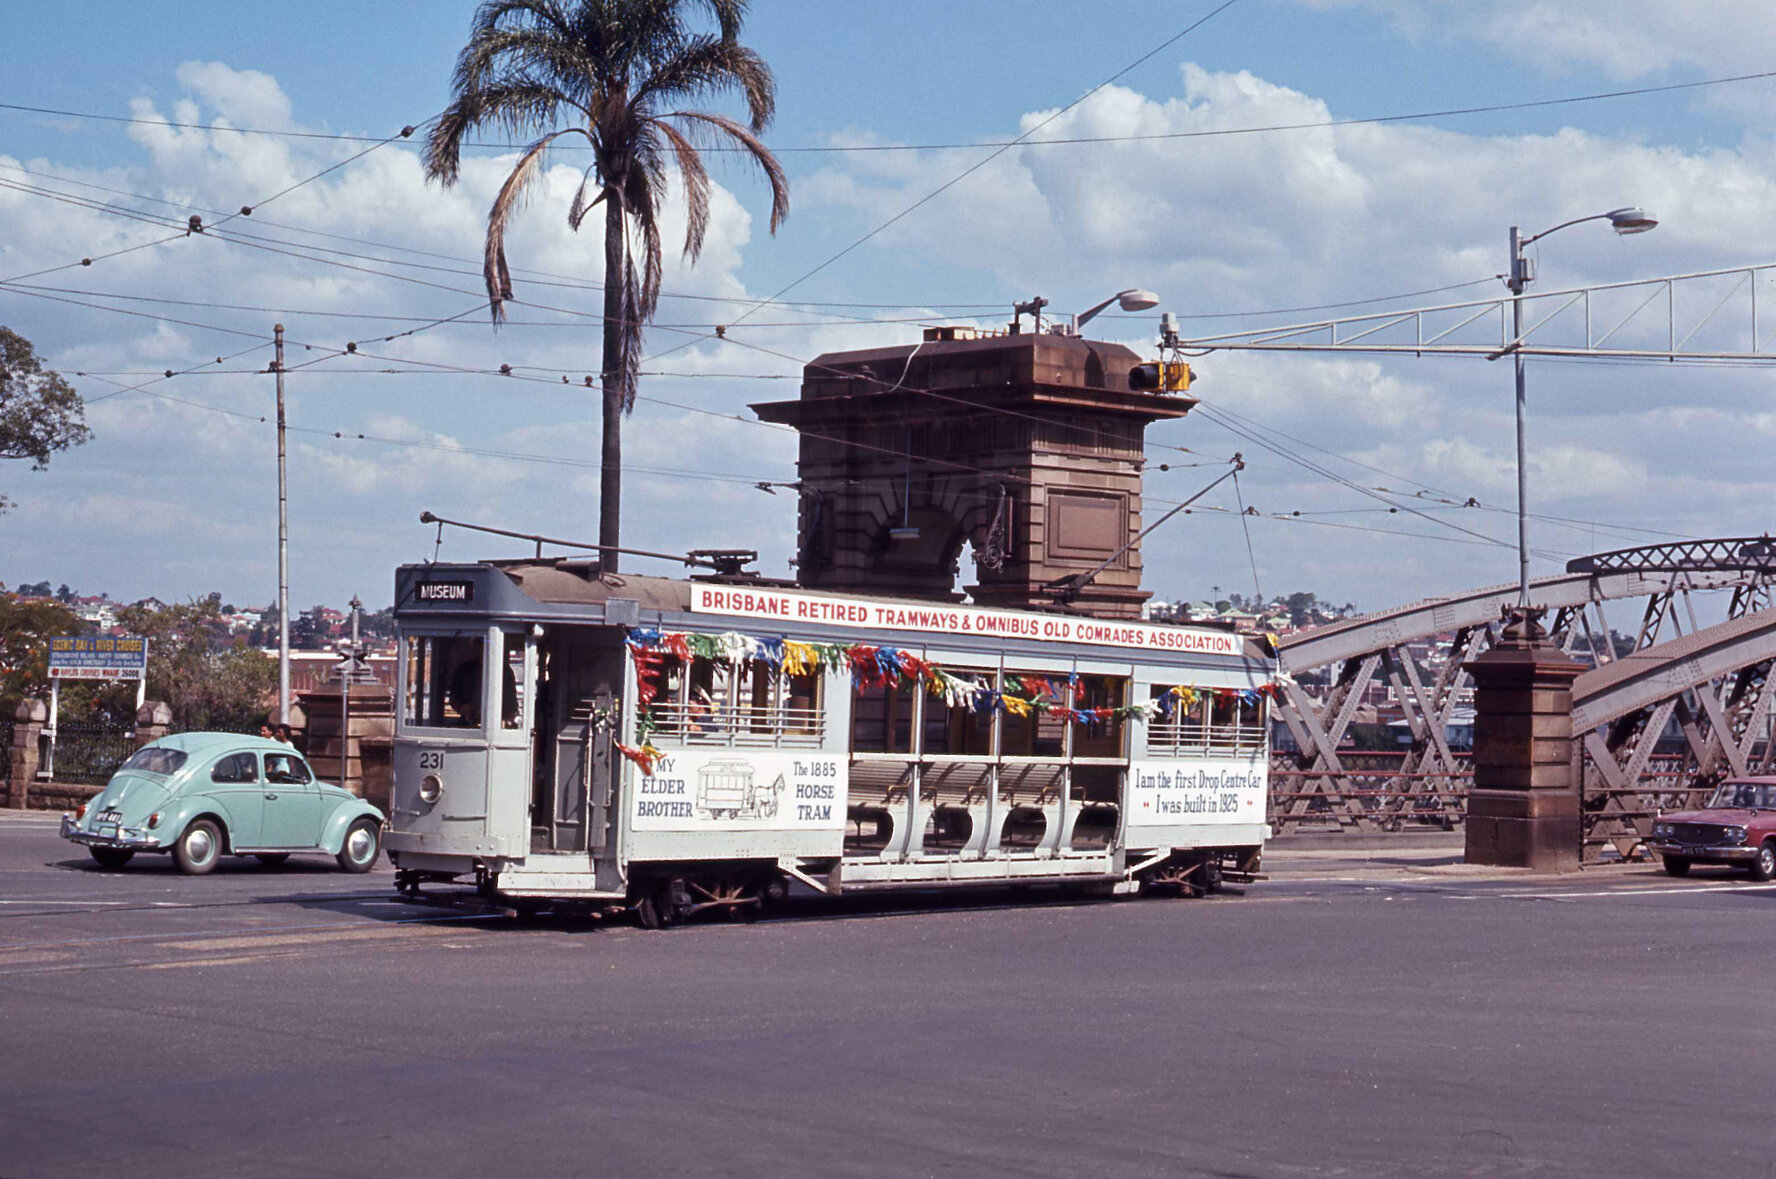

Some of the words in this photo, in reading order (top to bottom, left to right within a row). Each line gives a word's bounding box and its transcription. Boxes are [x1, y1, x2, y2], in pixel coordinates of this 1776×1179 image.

[421, 585, 465, 599] MUSEUM
[702, 591, 790, 615] BRISBANE
[798, 601, 868, 622] RETIRED
[875, 608, 959, 629] TRAMWAYS
[961, 615, 971, 630] &
[976, 615, 1039, 635] OMNIBUS
[1044, 622, 1070, 638] OLD
[1076, 624, 1144, 644] COMRADES
[1149, 632, 1232, 651] ASSOCIATION
[52, 639, 74, 651] SCENIC
[95, 639, 114, 651] RIVER
[116, 639, 142, 652] CRUISES
[420, 752, 444, 769] 231
[656, 759, 675, 772] MY
[793, 761, 808, 777] The
[811, 762, 837, 777] 1885
[641, 778, 685, 794] ELDER
[1136, 768, 1140, 788] I
[1141, 774, 1155, 788] am
[1158, 771, 1172, 788] the
[1175, 769, 1197, 788] first
[1198, 769, 1220, 794] Drop
[1221, 769, 1247, 788] Centre
[1248, 770, 1261, 788] Car
[796, 783, 834, 799] HORSE
[637, 801, 693, 817] BROTHER
[1156, 794, 1161, 813] I
[1162, 801, 1182, 813] was
[1184, 794, 1207, 813] built
[1208, 796, 1217, 812] in
[1219, 793, 1239, 812] 1925
[797, 804, 831, 820] TRAM
